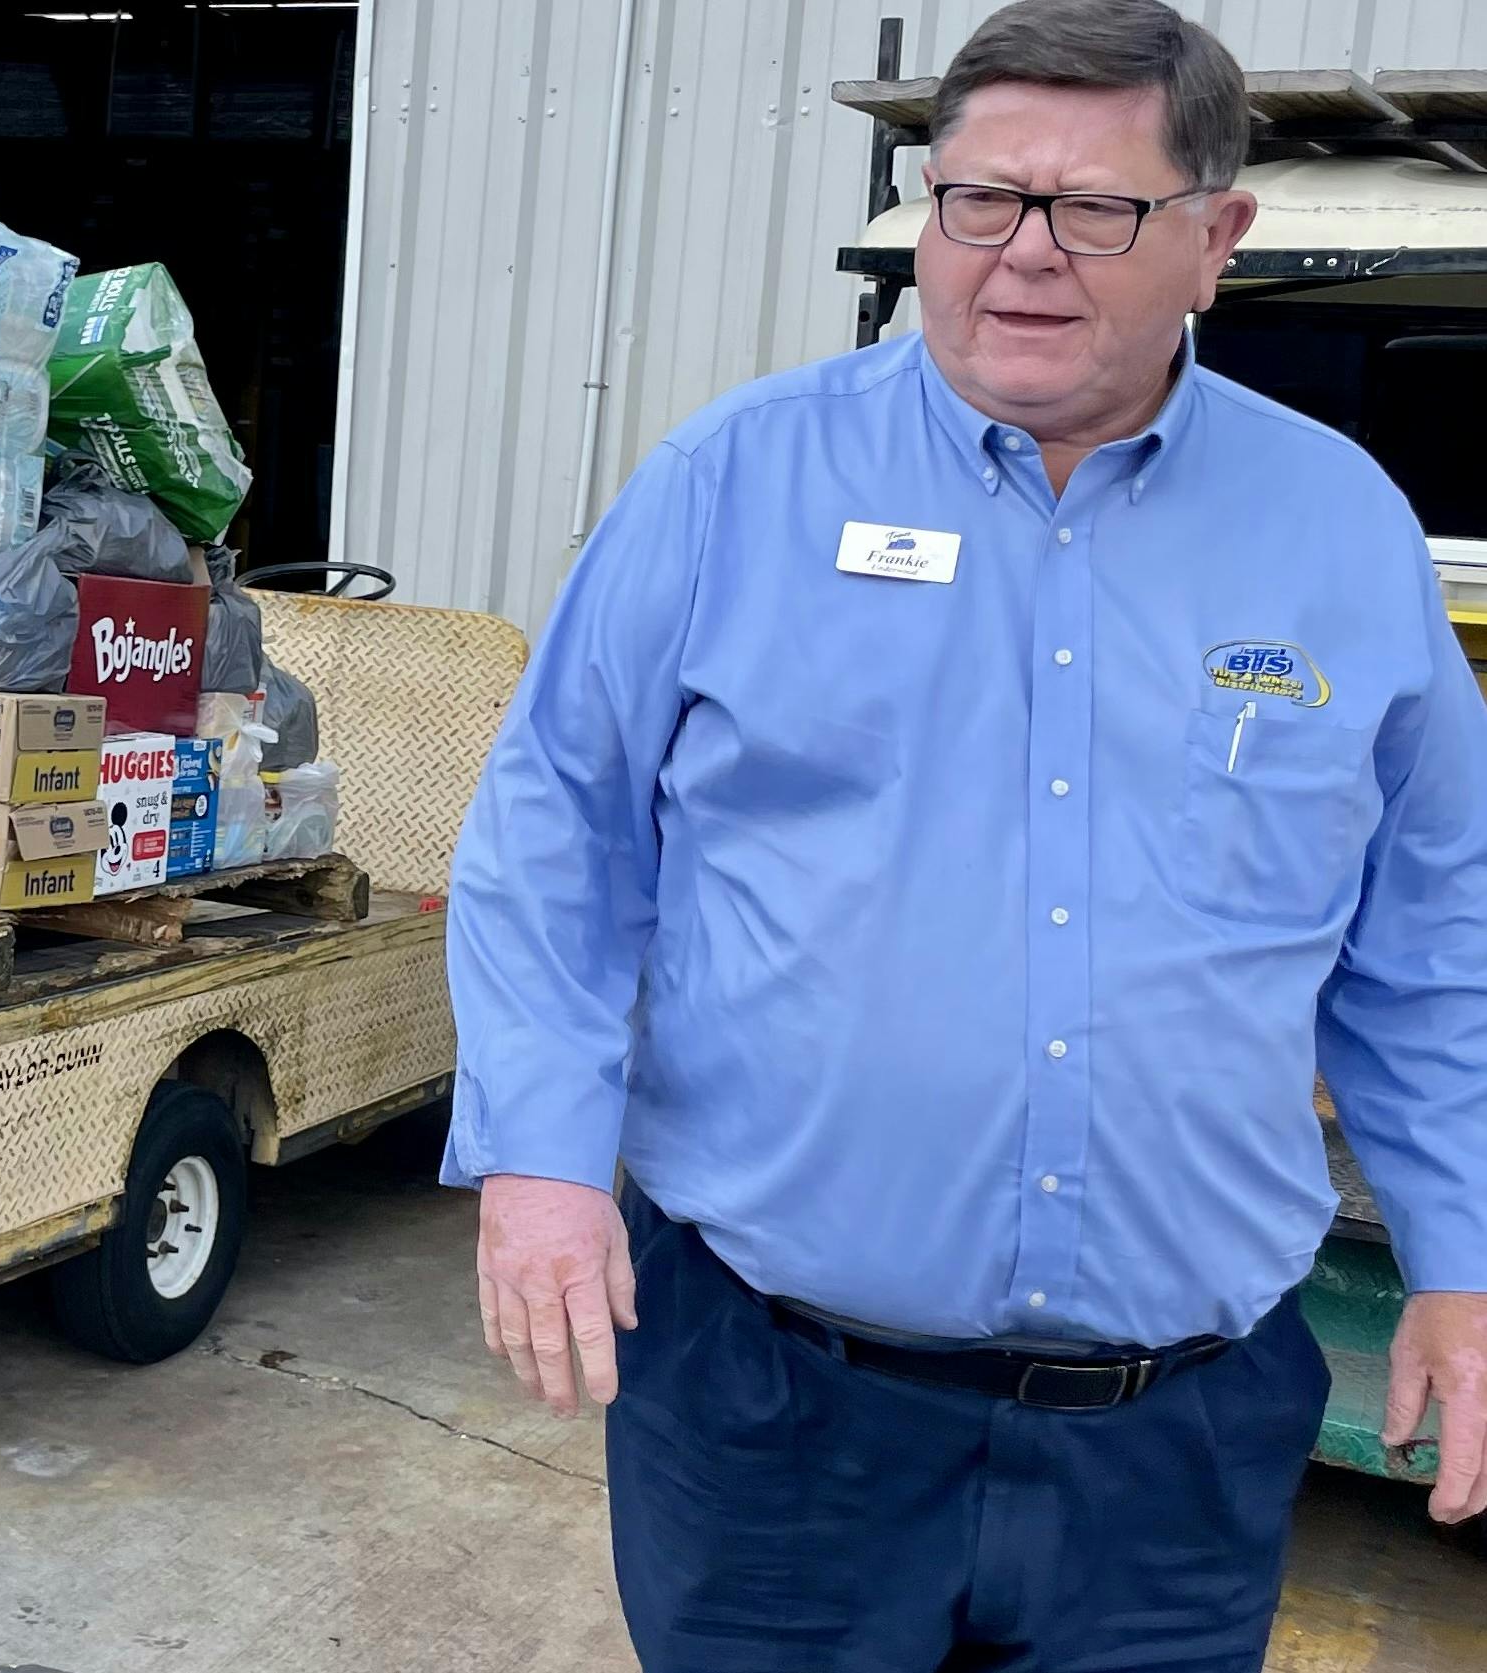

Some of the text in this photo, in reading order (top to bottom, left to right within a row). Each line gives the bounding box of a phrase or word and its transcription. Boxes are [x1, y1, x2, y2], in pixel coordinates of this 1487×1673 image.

[866, 550, 930, 569] Frankie
[91, 616, 194, 684] Bojangles
[1227, 648, 1294, 675] BTS
[1214, 677, 1304, 700] Distributors
[1258, 673, 1304, 690] Wheel
[33, 765, 81, 792] Infant
[99, 749, 176, 785] HUGGIES
[136, 791, 169, 810] snug &
[143, 810, 161, 827] dry
[152, 860, 160, 878] 4
[24, 869, 75, 897] Infant
